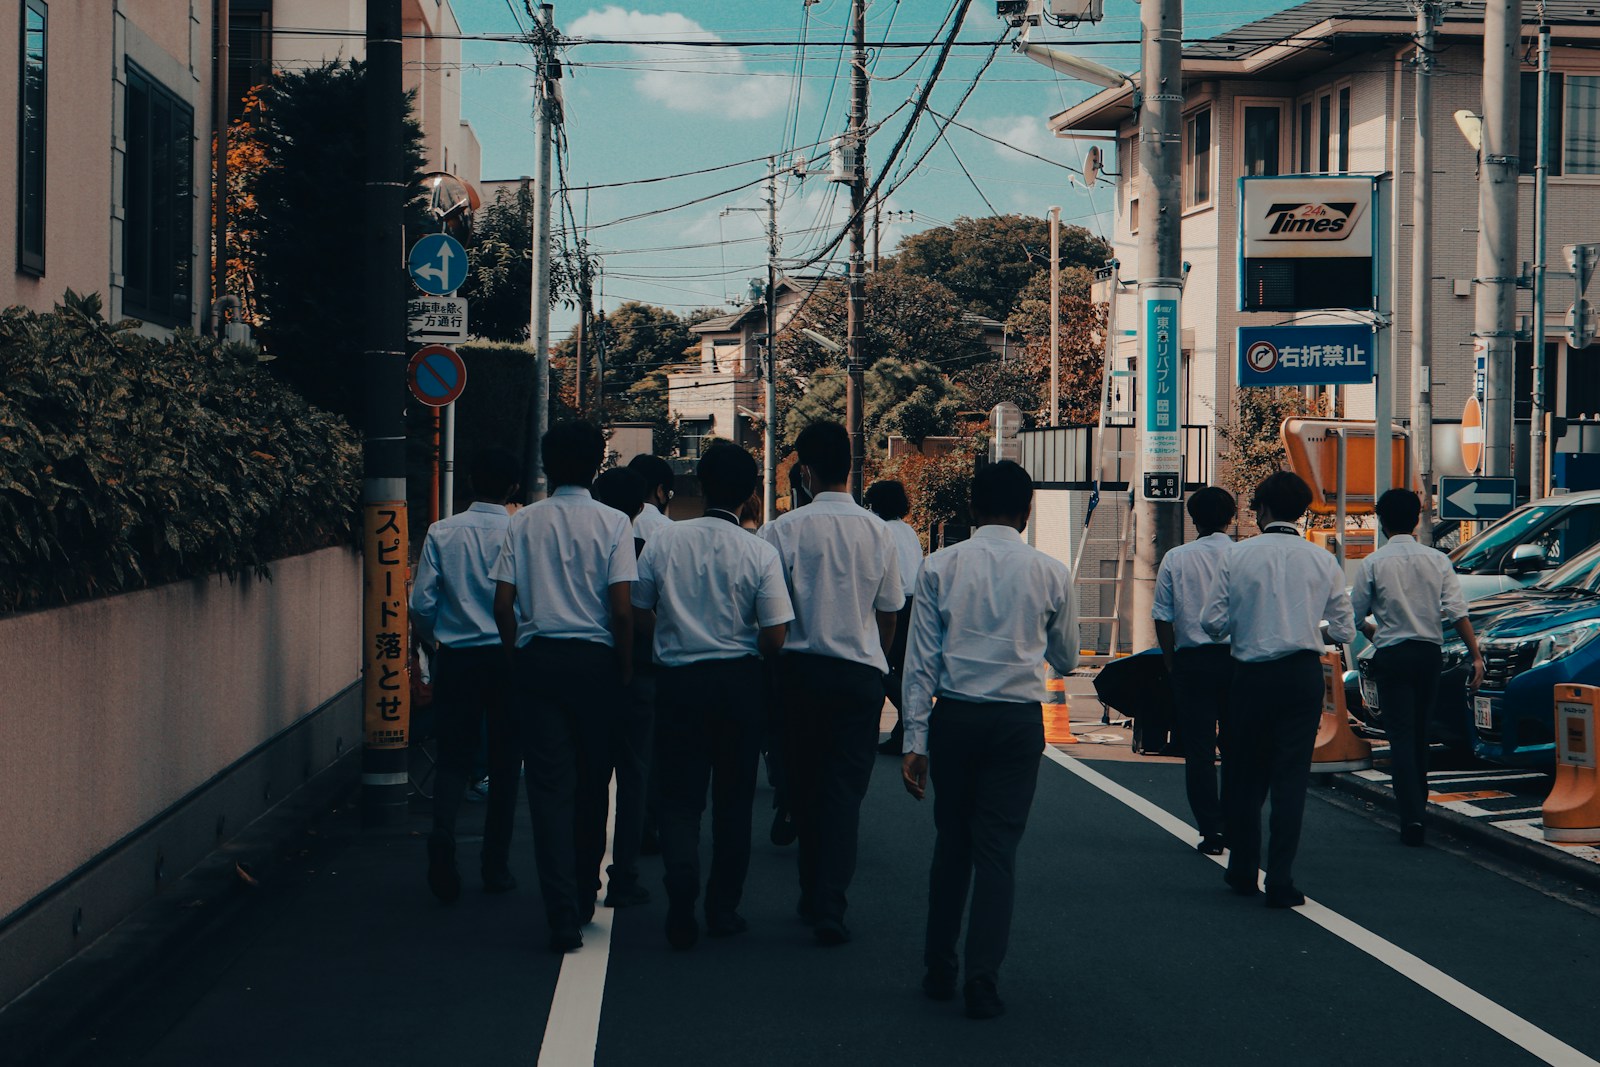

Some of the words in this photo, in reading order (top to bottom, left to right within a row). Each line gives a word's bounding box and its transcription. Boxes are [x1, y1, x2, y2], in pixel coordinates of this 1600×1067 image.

[1302, 205, 1326, 216] 24h
[1269, 212, 1346, 234] Times
[408, 315, 462, 328] 一方通行
[1156, 316, 1170, 394] 東急リバブル
[1278, 344, 1366, 368] 右折禁止
[375, 510, 402, 722] スピード落とせ
